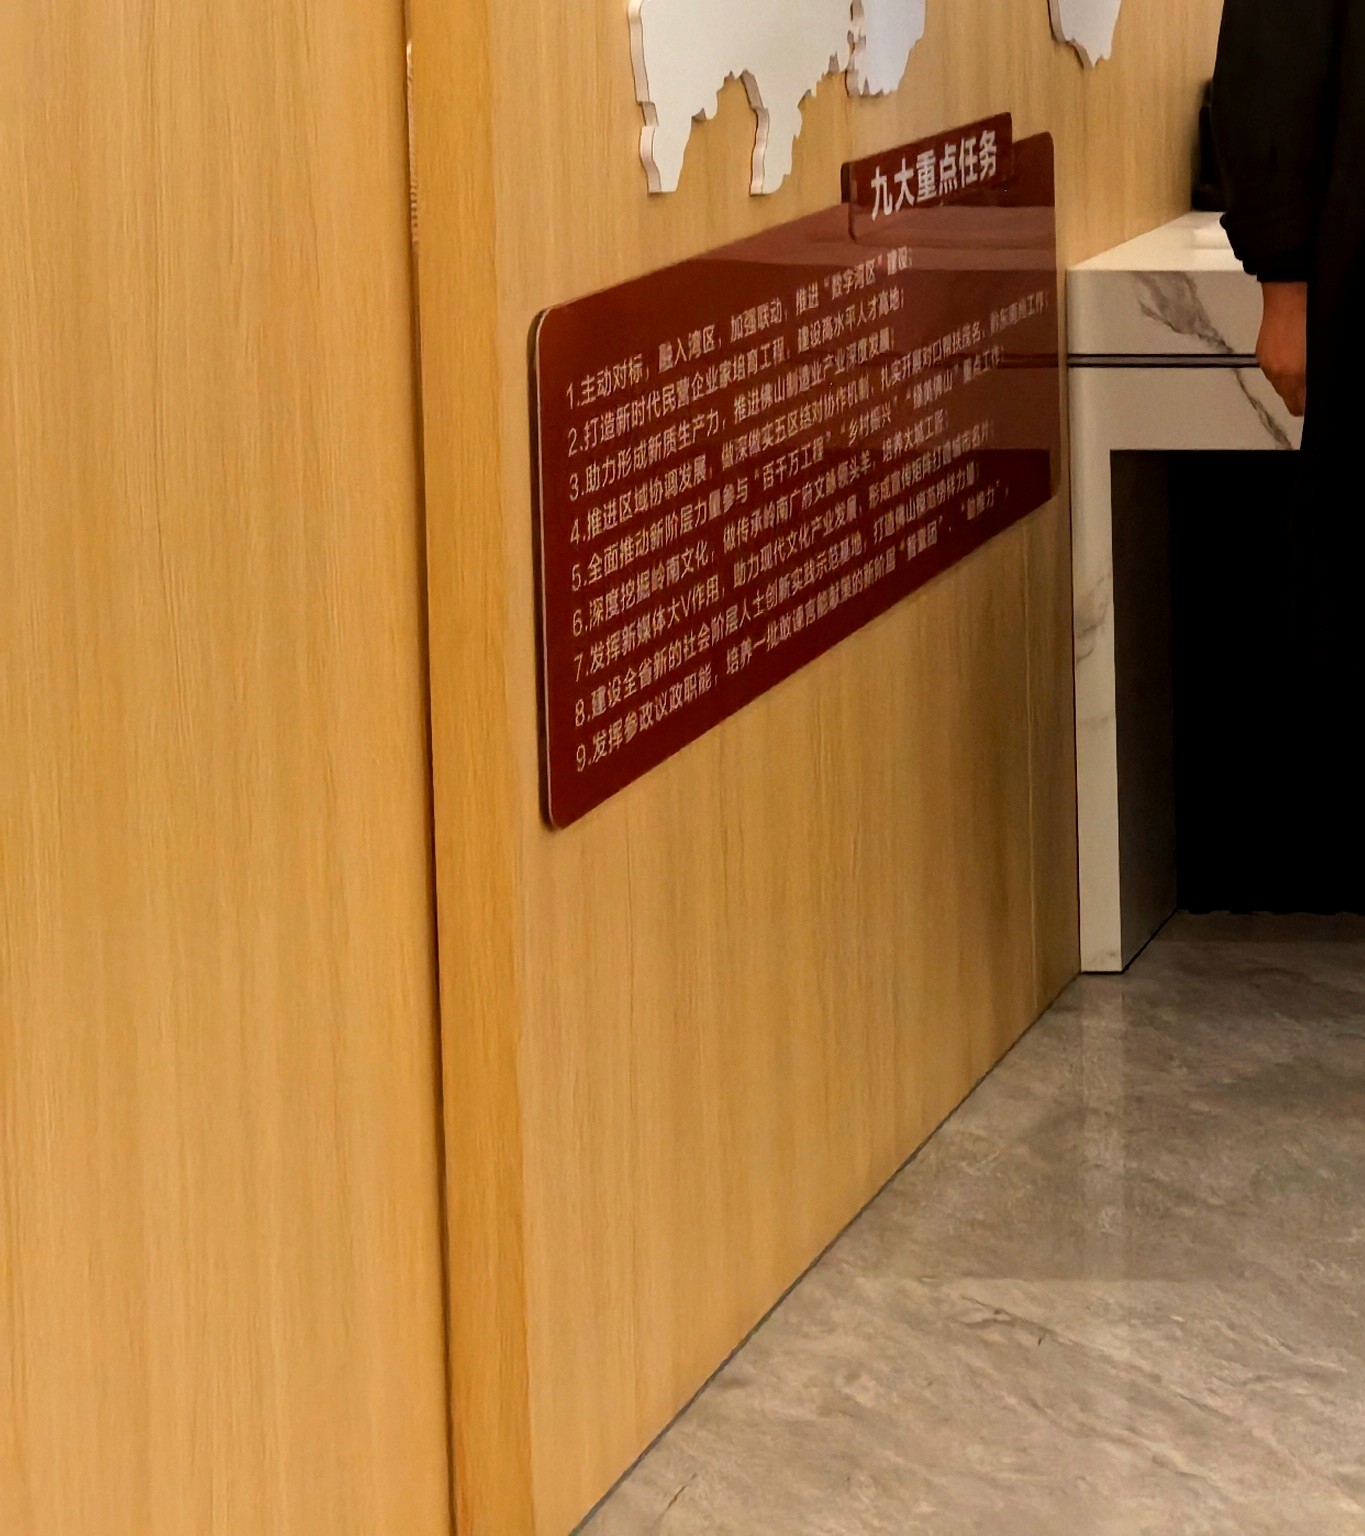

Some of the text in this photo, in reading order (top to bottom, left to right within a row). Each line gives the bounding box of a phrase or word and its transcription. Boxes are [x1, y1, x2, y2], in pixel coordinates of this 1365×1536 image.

[871, 130, 998, 222] 九大重点任务
